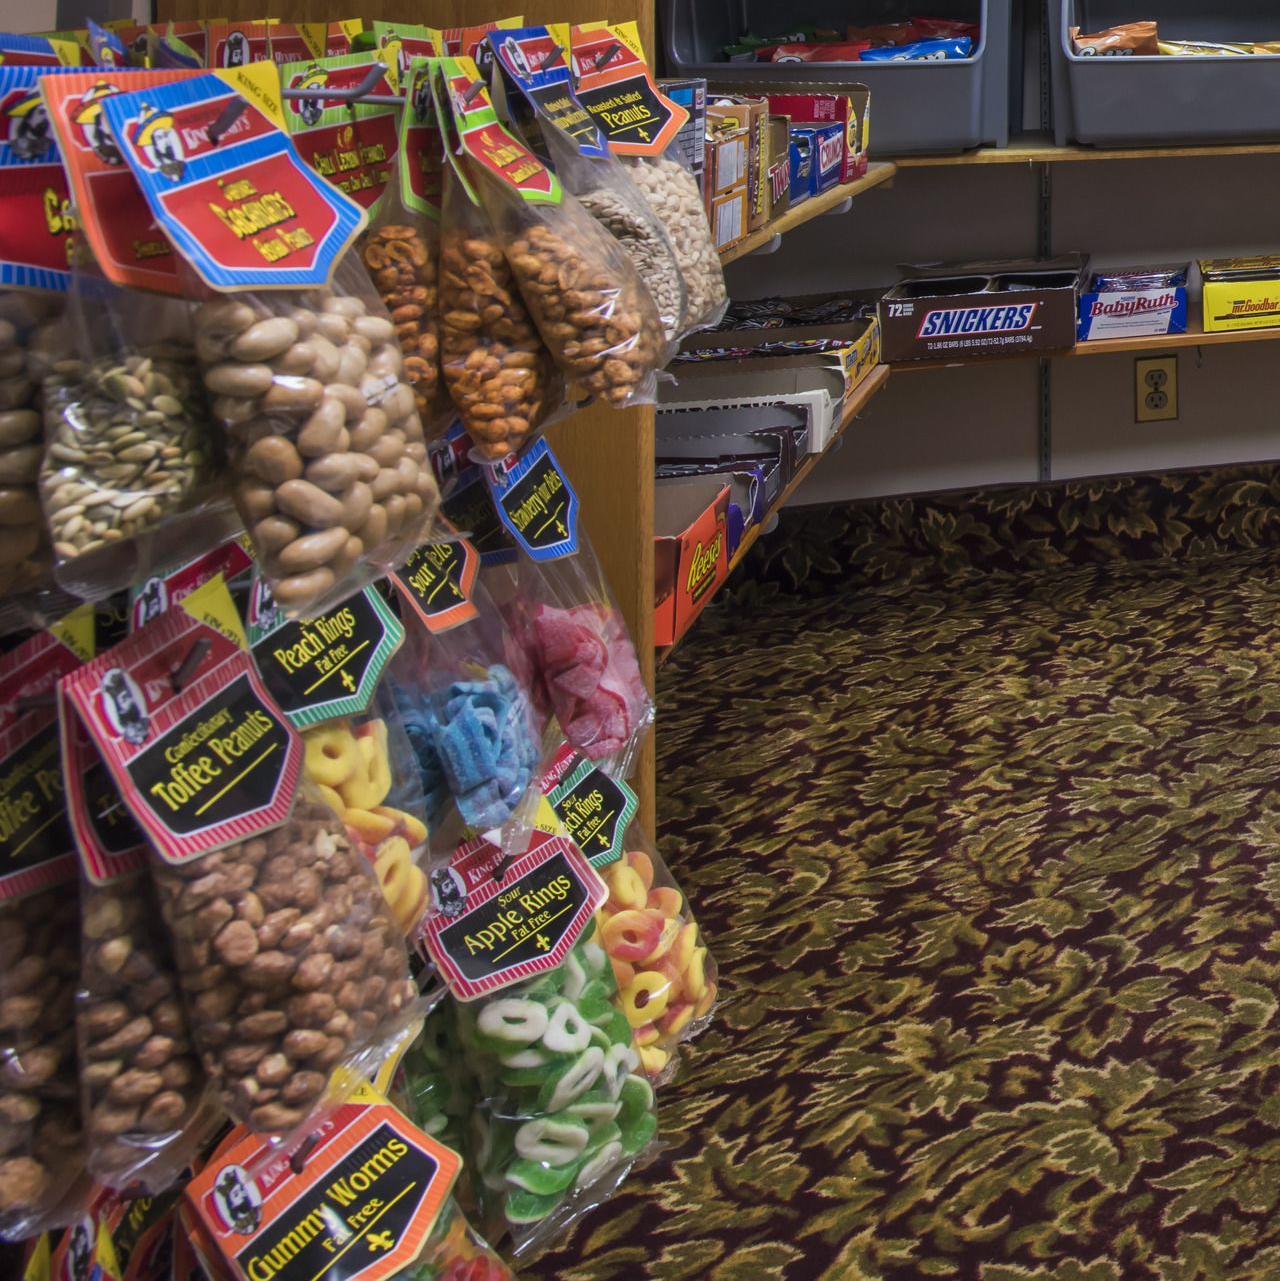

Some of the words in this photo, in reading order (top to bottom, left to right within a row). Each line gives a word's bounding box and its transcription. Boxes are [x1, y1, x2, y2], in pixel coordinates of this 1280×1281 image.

[601, 105, 651, 128] Peanuts
[888, 303, 902, 317] 72
[924, 303, 1032, 336] SNICKERS
[273, 630, 324, 674] Peach
[318, 607, 356, 647] Rings
[314, 656, 332, 674] Fat
[328, 643, 349, 665] Free
[151, 756, 222, 811] Toffee
[207, 709, 274, 765] Peanuts
[576, 789, 604, 820] Rings
[497, 885, 522, 908] Sour
[463, 906, 524, 956] Apple
[518, 873, 572, 916] Rings
[510, 925, 530, 943] Fat
[527, 909, 552, 932] Free
[248, 1203, 328, 1281] Gummy
[325, 1138, 408, 1208] Worms
